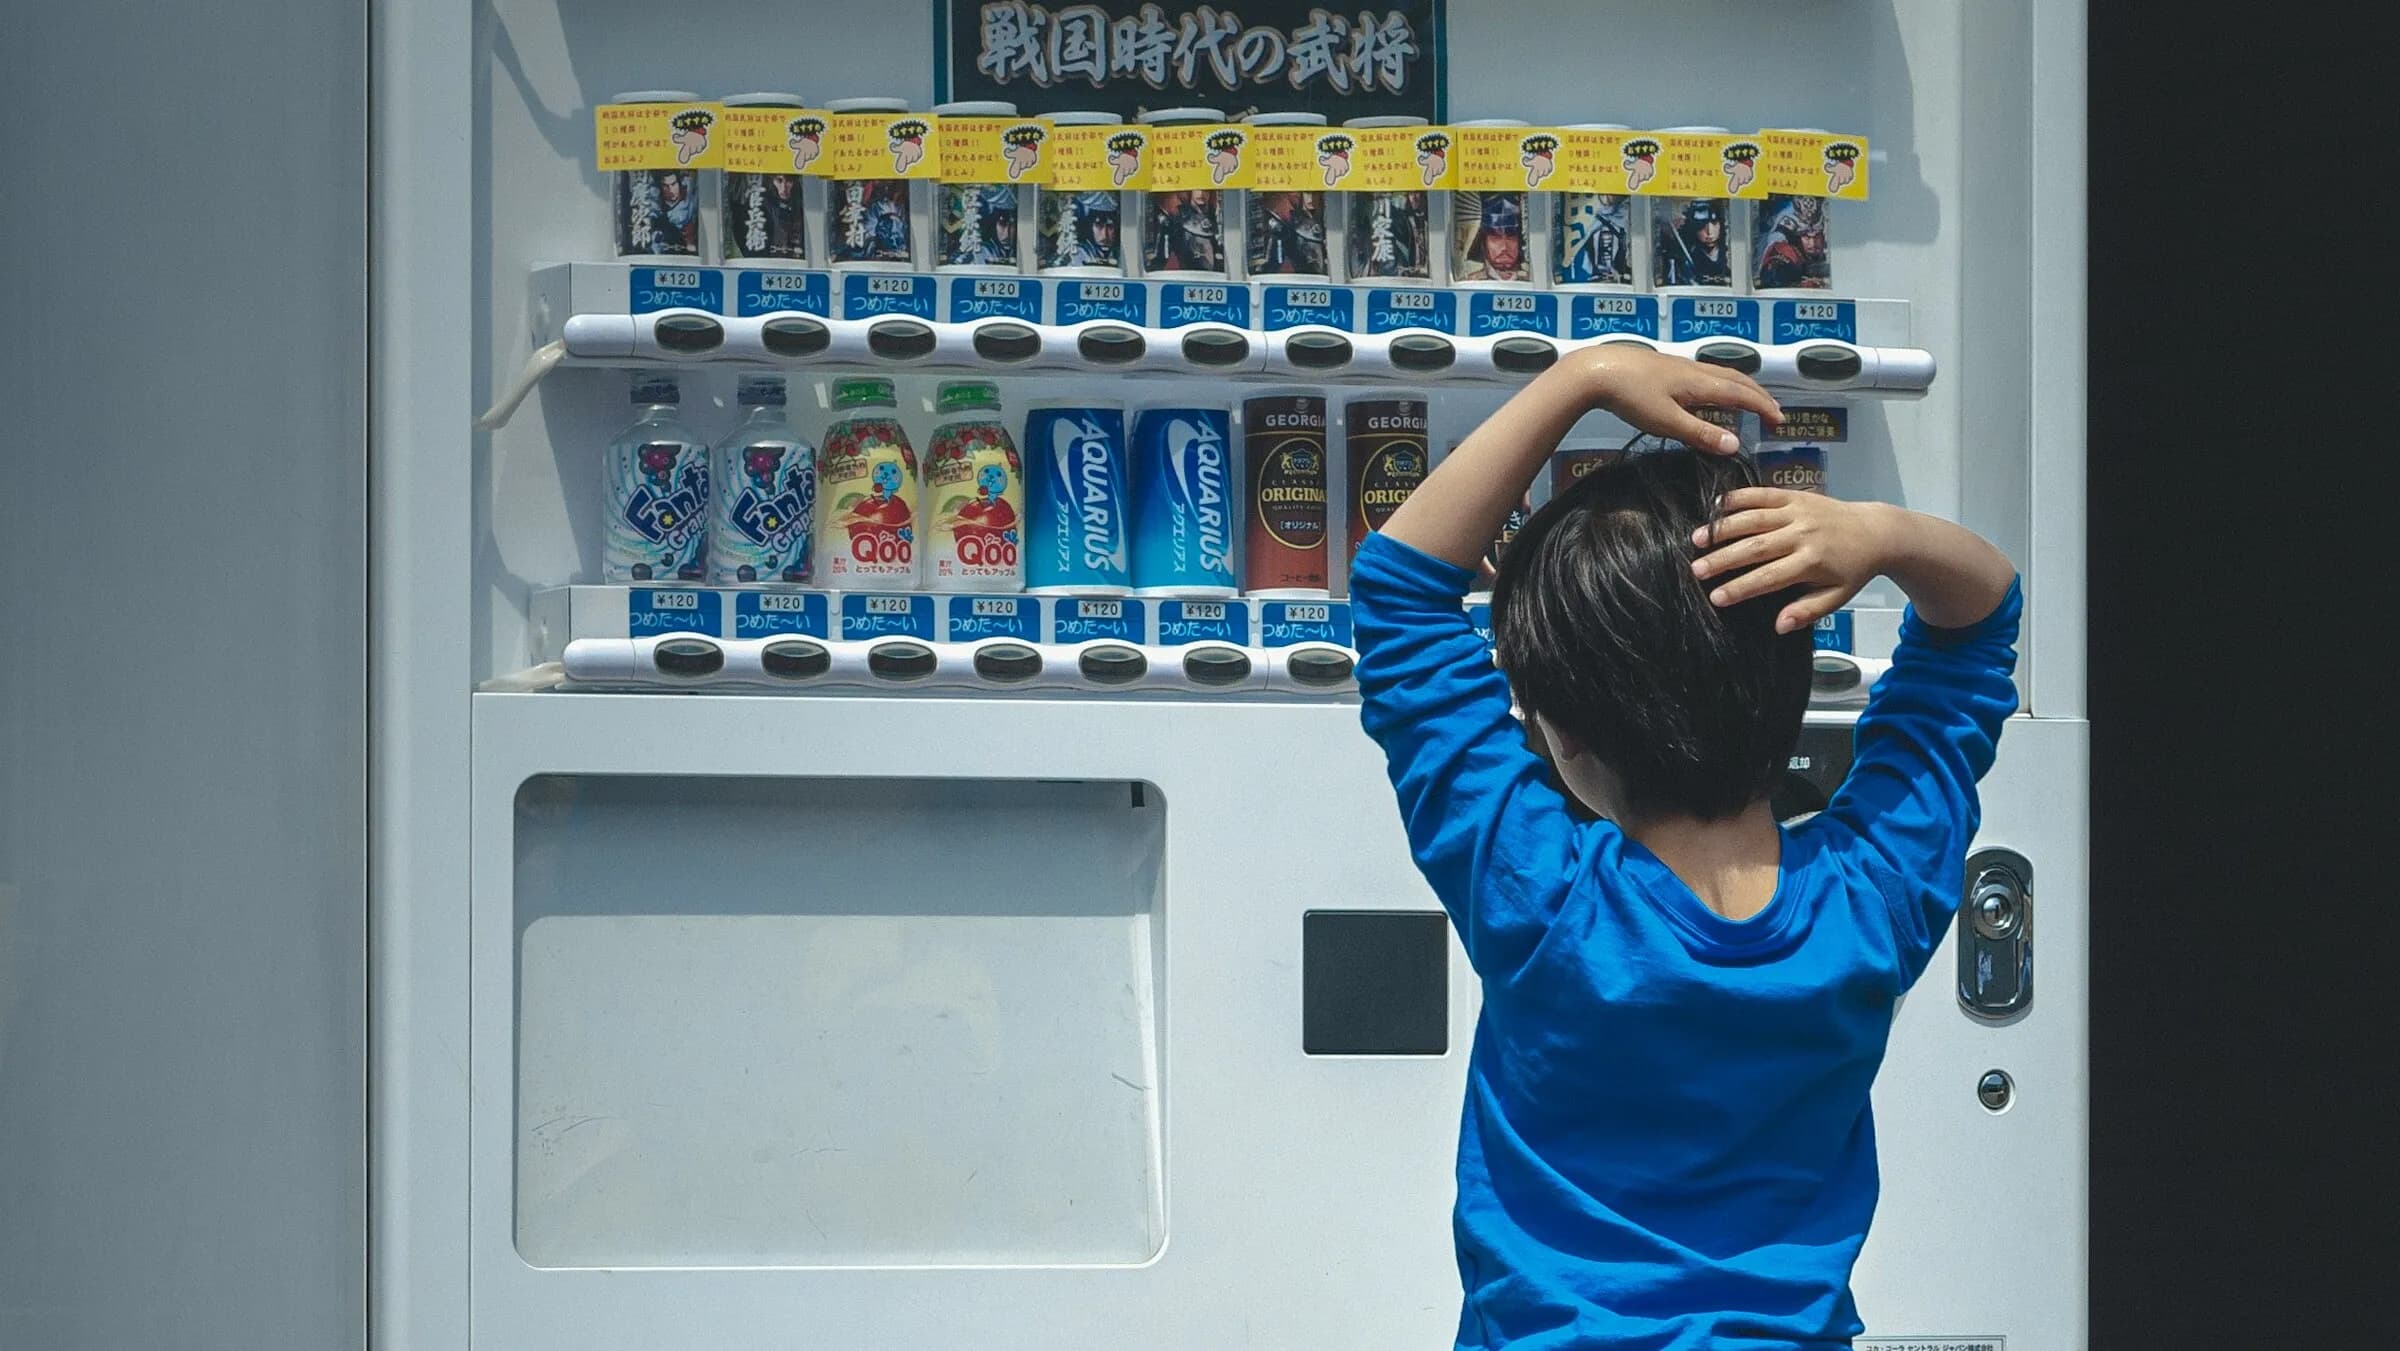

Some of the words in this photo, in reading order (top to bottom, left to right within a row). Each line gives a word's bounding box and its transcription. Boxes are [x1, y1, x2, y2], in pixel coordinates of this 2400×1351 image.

[980, 0, 1419, 92] 戦国時代の武将
[659, 273, 696, 286] ¥120
[766, 276, 802, 289] ¥120
[872, 280, 909, 292] ¥120
[979, 282, 1015, 295] ¥120
[1084, 285, 1120, 298] ¥120
[1189, 288, 1224, 301] ¥120
[1291, 292, 1327, 304] ¥120
[1394, 295, 1430, 307] ¥120
[1497, 298, 1532, 310] ¥120
[1598, 300, 1633, 313] ¥120
[1699, 303, 1734, 315] ¥120
[1799, 305, 1834, 318] ¥120
[1081, 418, 1110, 572] AQUARIUS
[1197, 420, 1223, 573] AQUARIUS
[623, 461, 709, 545] Fanta
[729, 463, 816, 547] Fanta
[667, 508, 709, 550] Grap
[1057, 501, 1070, 573] アクエリアス
[1172, 502, 1186, 573] アクエリアス
[851, 532, 912, 564] Qoo
[957, 535, 1017, 566] Qoo
[856, 565, 911, 574] とってもアップル
[961, 568, 1016, 577] とってもアップル
[657, 595, 695, 608] ¥120
[764, 597, 800, 610] ¥120
[870, 599, 907, 612] ¥120
[977, 601, 1013, 614] ¥120
[1082, 602, 1118, 616] ¥120
[1186, 604, 1222, 617] ¥120
[1289, 607, 1326, 619] ¥120
